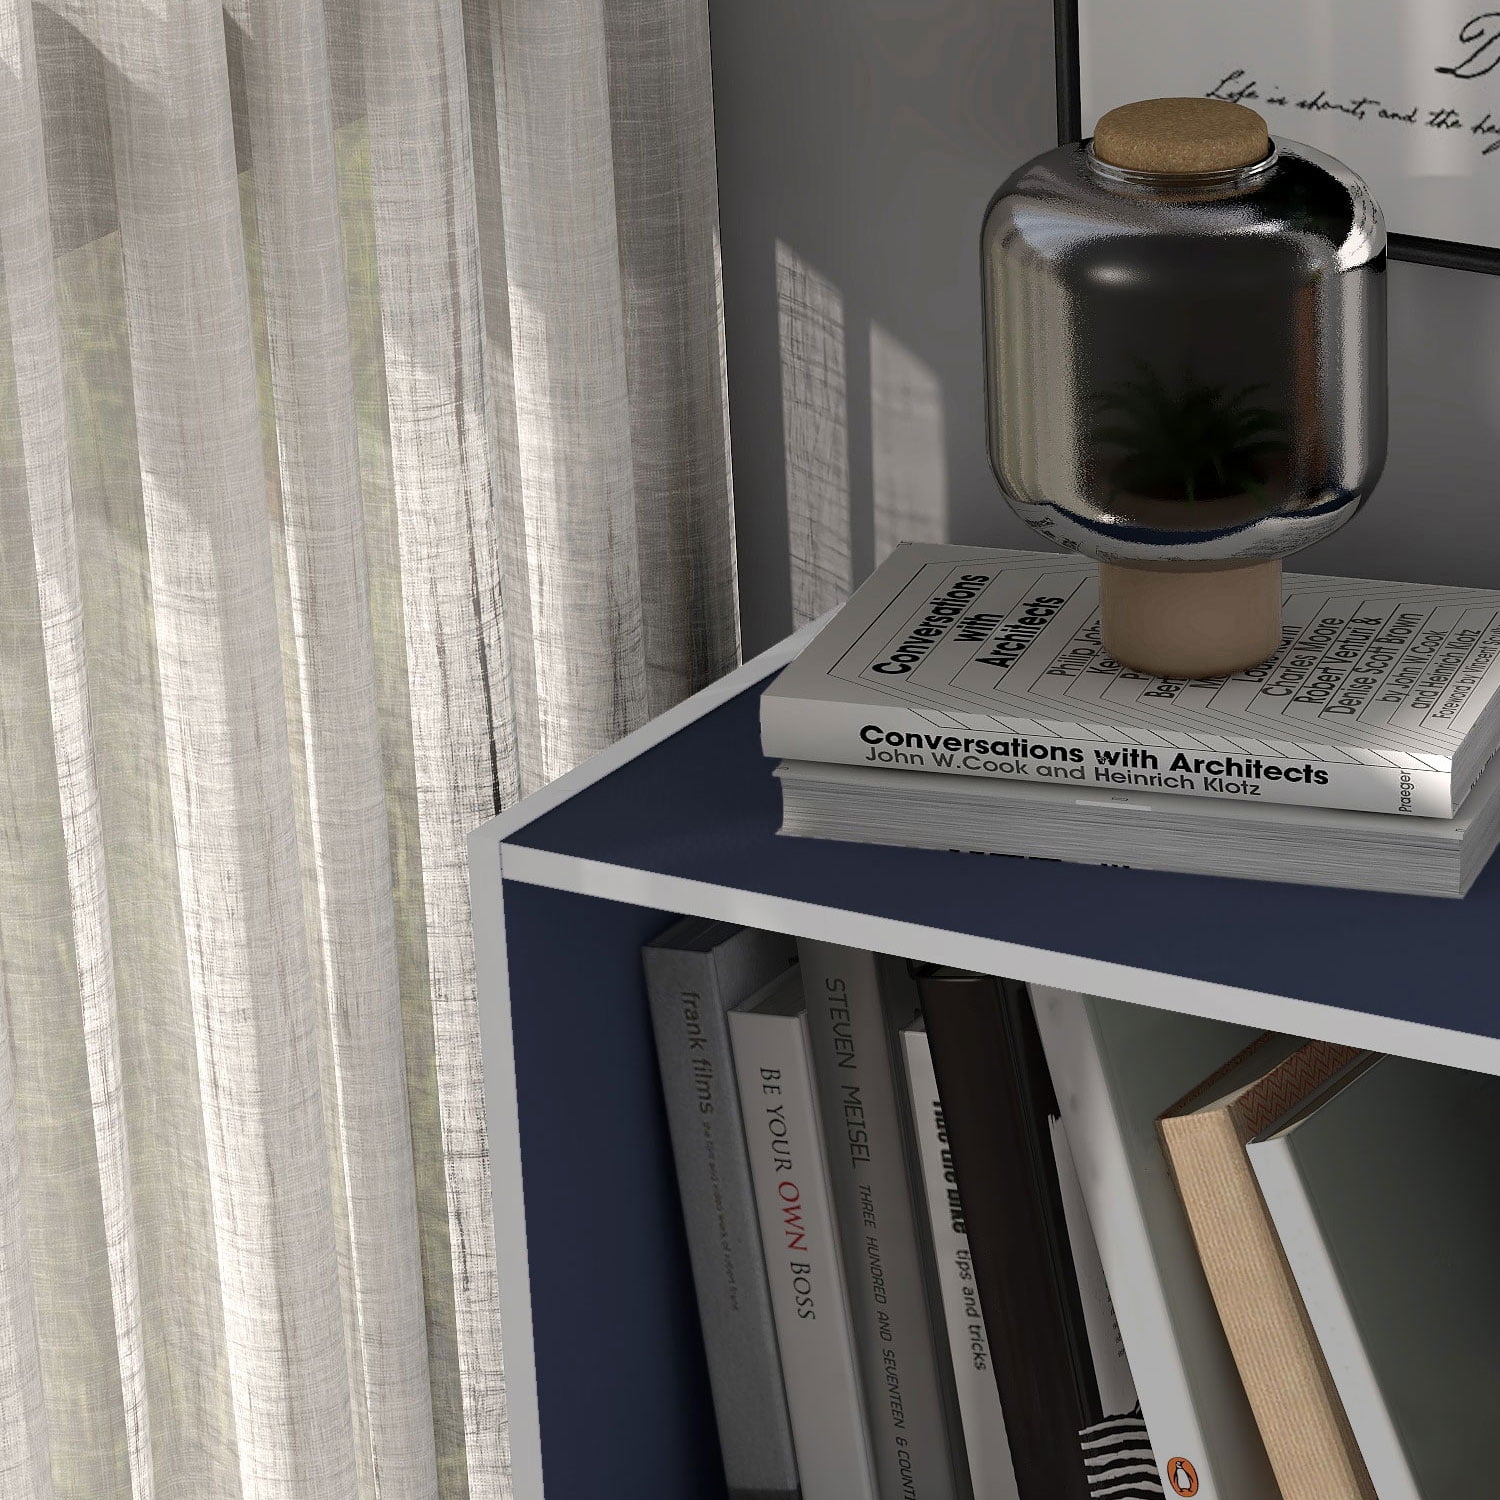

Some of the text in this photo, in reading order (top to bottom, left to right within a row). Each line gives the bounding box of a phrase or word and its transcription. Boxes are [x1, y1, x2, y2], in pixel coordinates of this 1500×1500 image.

[1379, 108, 1417, 124] and
[1426, 109, 1462, 128] the
[871, 574, 990, 675] Conversations
[953, 613, 1004, 642] with
[975, 596, 1065, 669] Architects
[1046, 647, 1095, 677] Philip
[1262, 655, 1318, 697] Charles
[1294, 617, 1345, 652] Moore
[1293, 626, 1376, 704] Robert Venturi
[1324, 613, 1424, 715] Denise Scott Brown
[1386, 667, 1423, 689] John
[1411, 629, 1482, 709] and Heinrich Klotz
[1456, 674, 1483, 685] by
[1462, 646, 1499, 673] Vincent
[1375, 690, 1410, 702] by
[1432, 684, 1473, 719] Foreword
[860, 725, 1329, 786] Conversations with Architects
[865, 747, 925, 767] John
[1036, 759, 1086, 781] and
[1094, 766, 1196, 791] Heinrich
[1203, 774, 1262, 797] Klotz
[1398, 770, 1412, 813] Praeger
[681, 991, 714, 1115] frank films
[841, 1085, 871, 1169] MEISEL
[760, 1066, 816, 1321] BE YOUR OWN BOSS
[859, 1184, 877, 1228] THREE
[866, 1236, 888, 1304] HUNDRED
[877, 1311, 893, 1342] AND
[955, 1250, 986, 1372] tips and tricks
